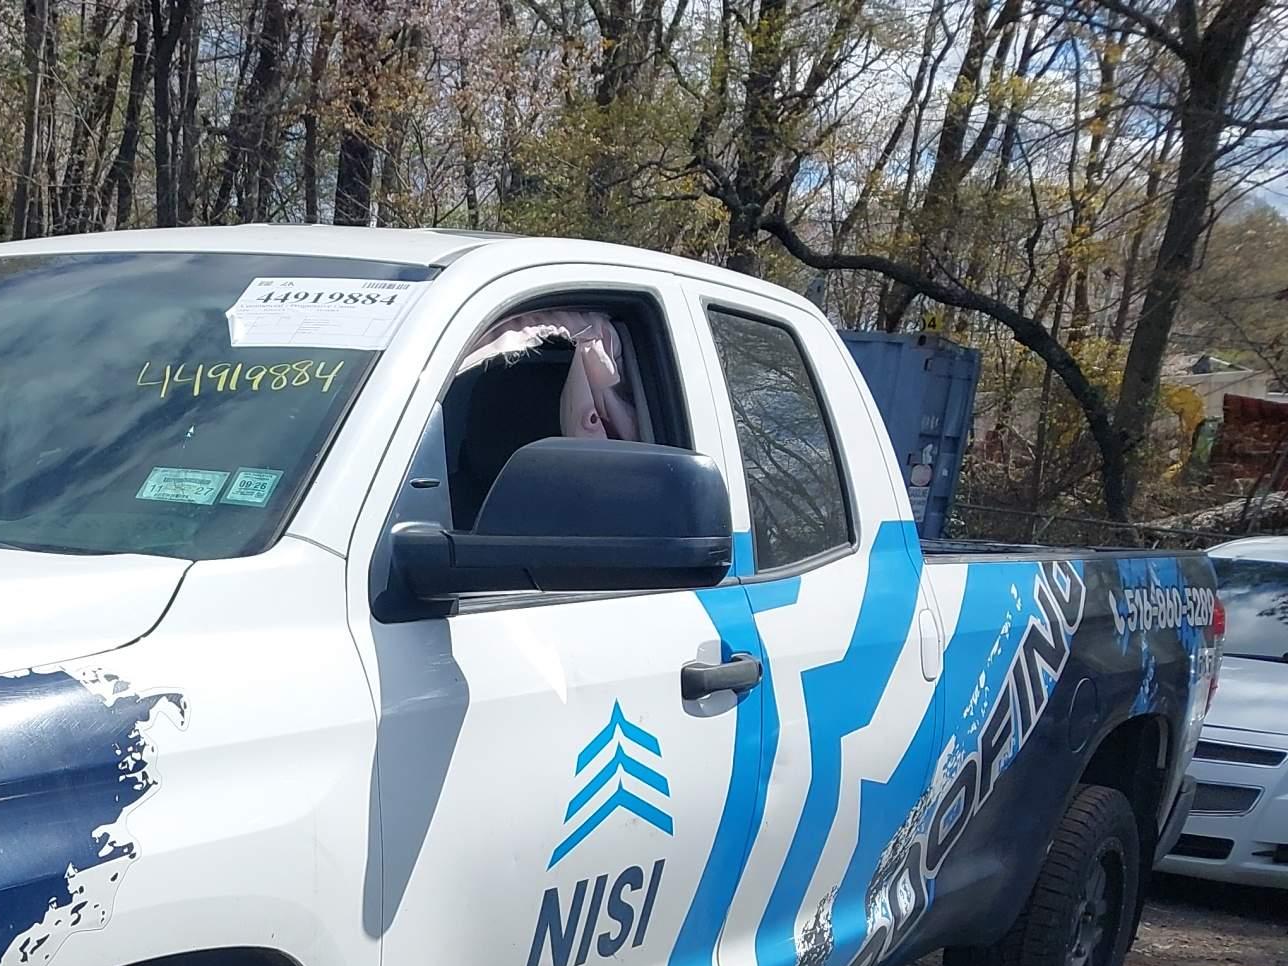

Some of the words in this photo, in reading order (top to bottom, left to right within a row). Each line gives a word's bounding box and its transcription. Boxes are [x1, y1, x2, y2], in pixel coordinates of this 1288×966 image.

[256, 291, 399, 306] 44919884
[137, 361, 345, 398] 44919884
[1123, 587, 1215, 632] 516-860-5289
